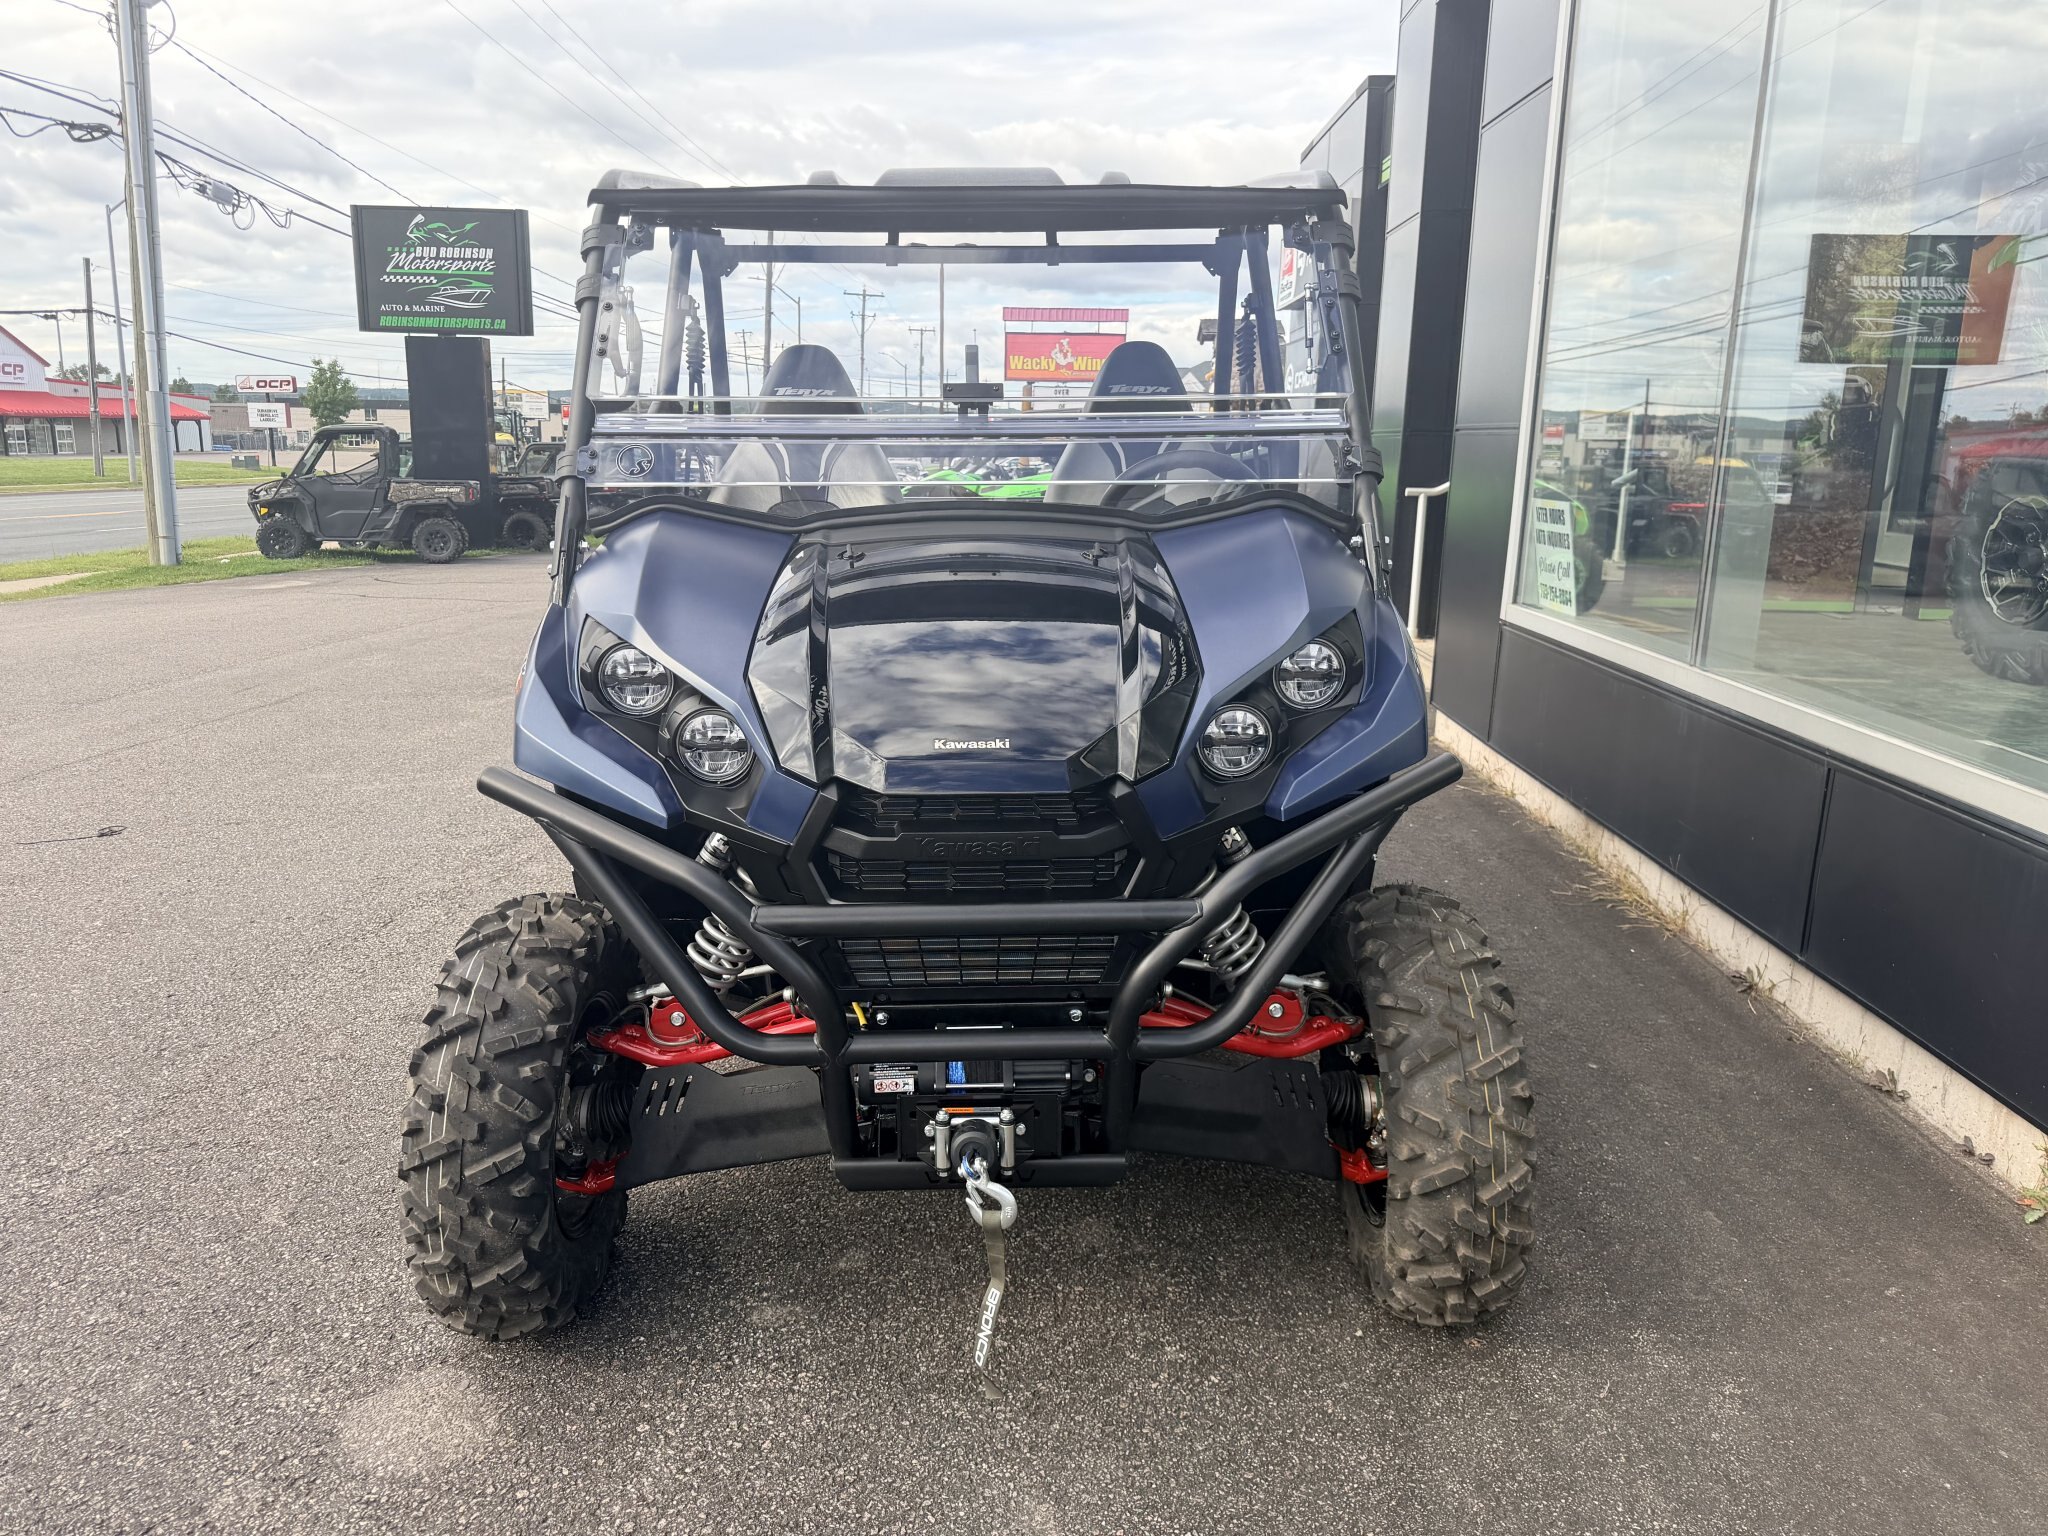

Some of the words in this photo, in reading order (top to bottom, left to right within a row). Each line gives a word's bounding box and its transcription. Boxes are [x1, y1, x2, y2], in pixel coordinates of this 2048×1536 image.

[415, 246, 436, 258] BUD
[439, 246, 494, 259] ROBINSON
[386, 251, 497, 274] Motorsports
[380, 304, 403, 312] AUTO
[412, 305, 446, 313] MARINE
[379, 315, 507, 330] ROBINSONMOTORSPORTS.CA
[0, 363, 24, 376] CP
[1009, 355, 1057, 372] Wacky
[256, 379, 291, 389] OCP
[1053, 388, 1070, 396] OVER
[1535, 506, 1548, 523] AFTER
[1548, 508, 1566, 526] HOURS
[1547, 530, 1571, 550] INQUIRIES
[1539, 556, 1556, 575] Please
[1557, 561, 1571, 581] Call
[934, 738, 1011, 749] Kawasaki
[914, 836, 1041, 859] Kawasaki
[974, 1287, 1001, 1367] BRONCO
